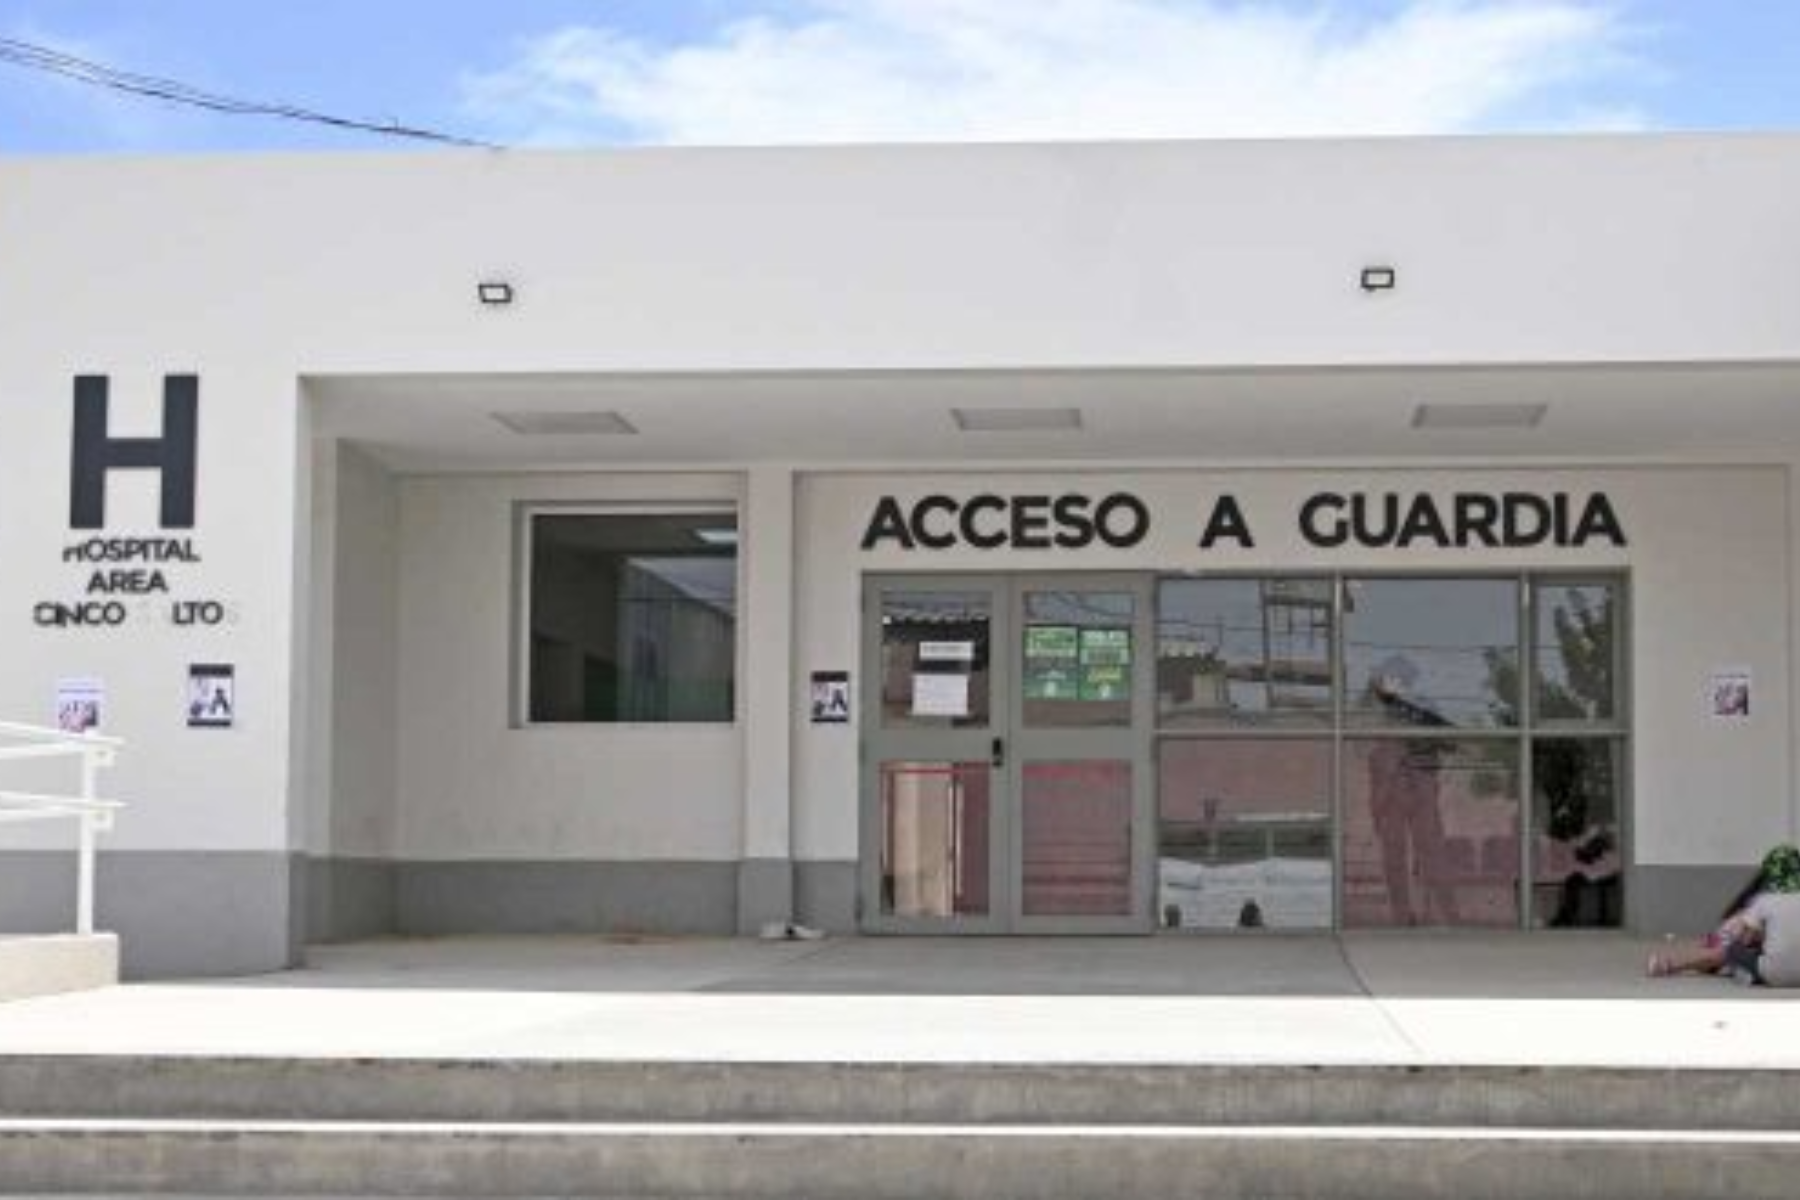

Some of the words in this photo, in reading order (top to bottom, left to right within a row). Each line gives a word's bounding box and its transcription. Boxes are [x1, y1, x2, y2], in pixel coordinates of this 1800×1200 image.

[70, 374, 198, 529] H
[861, 492, 1150, 550] ACCESO
[1199, 495, 1254, 549] A
[1299, 492, 1627, 549] GUARDIA
[86, 569, 169, 594] AREA
[33, 600, 127, 627] CINCO
